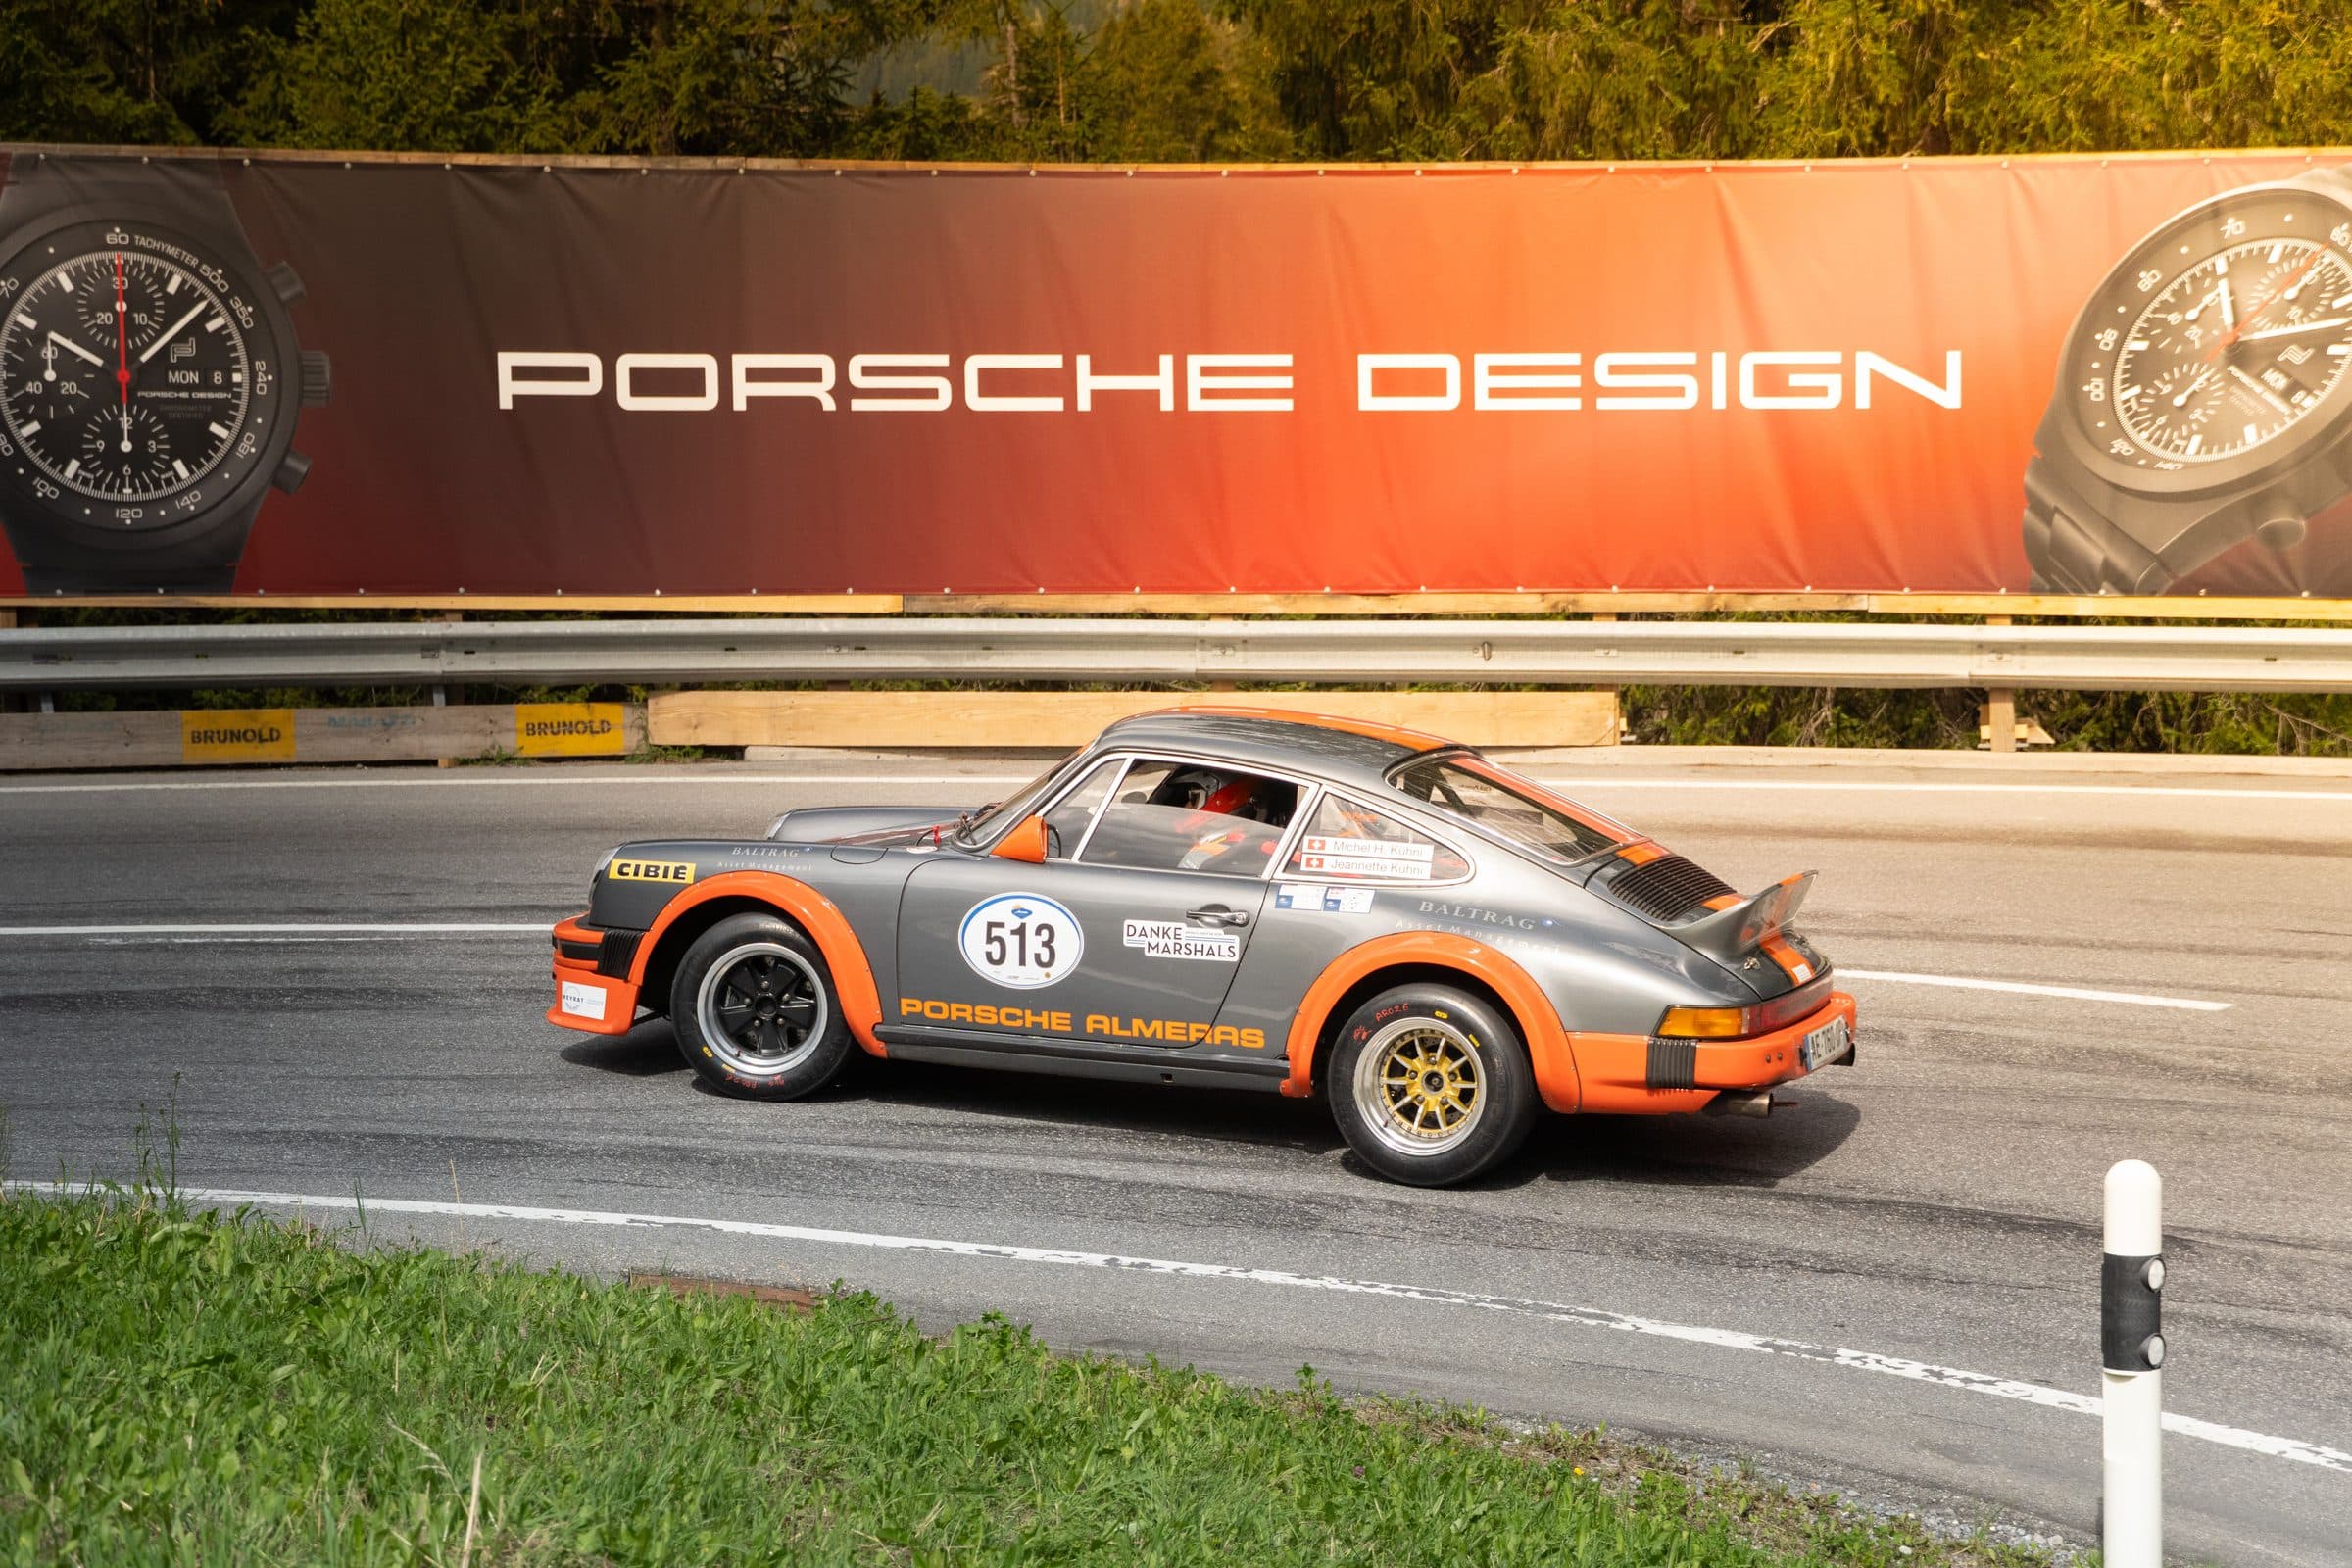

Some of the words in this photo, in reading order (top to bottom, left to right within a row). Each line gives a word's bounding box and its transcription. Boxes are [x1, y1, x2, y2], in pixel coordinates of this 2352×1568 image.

[106, 233, 129, 244] 60
[133, 235, 199, 269] TACHYMETER
[199, 264, 229, 293] 500
[97, 312, 113, 325] 20
[133, 312, 148, 325] 10
[229, 296, 254, 329] 350
[168, 370, 199, 384] MON
[214, 370, 222, 384] 8
[255, 361, 267, 395] 240
[498, 351, 1294, 412] PORSCHE
[1358, 350, 1962, 411] DESIGN
[25, 381, 43, 395] 40
[60, 381, 77, 395] 20
[96, 440, 105, 452] 9
[148, 440, 157, 453] 3
[235, 432, 255, 459] 180
[122, 464, 131, 475] 6
[32, 477, 59, 500] 100
[175, 490, 202, 510] 140
[115, 508, 143, 518] 120
[191, 726, 282, 744] BRUNOLD
[526, 719, 612, 736] BRUNOLD
[731, 846, 801, 858] BALTRAG
[1333, 841, 1370, 852] Michel
[1419, 901, 1536, 930] BALTRAG
[1127, 925, 1183, 940] DANKE
[985, 921, 1056, 968] 513
[1147, 942, 1237, 958] MARSHALS
[900, 998, 1072, 1032] PORSCHE
[1086, 1015, 1265, 1050] ALMERAS
